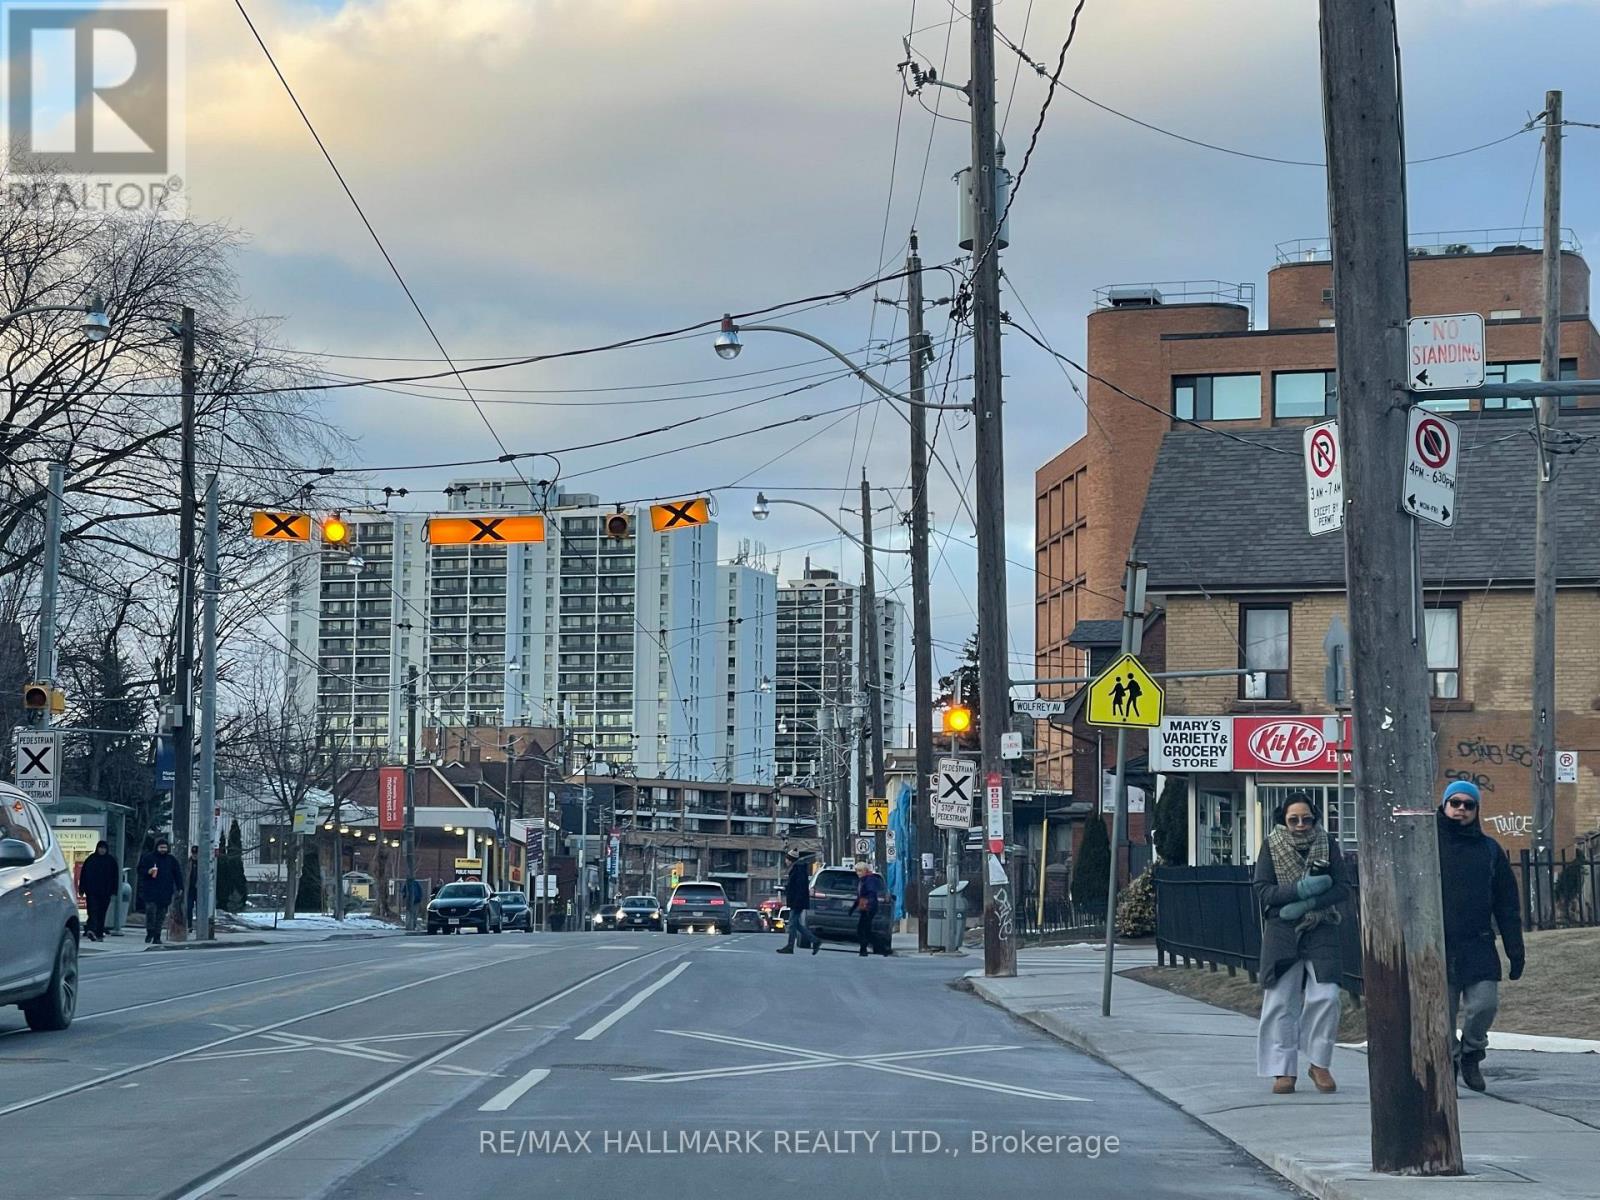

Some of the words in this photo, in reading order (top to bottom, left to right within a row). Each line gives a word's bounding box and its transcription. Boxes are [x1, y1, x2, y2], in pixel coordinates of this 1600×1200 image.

[1432, 320, 1459, 341] NO
[1412, 343, 1481, 366] STANDING
[1016, 702, 1051, 712] WOLFREY
[1052, 703, 1061, 712] AV
[1169, 719, 1221, 731] MARY'S
[20, 736, 54, 745] PEDESTRIAN
[1162, 732, 1219, 744] VARIETY
[1220, 734, 1228, 744] &
[1163, 745, 1227, 757] GROCERY
[942, 764, 973, 773] PEDESTRIAN
[1172, 758, 1218, 768] STORE
[941, 804, 954, 812] STOP
[937, 812, 968, 823] PEDESTRIANS
